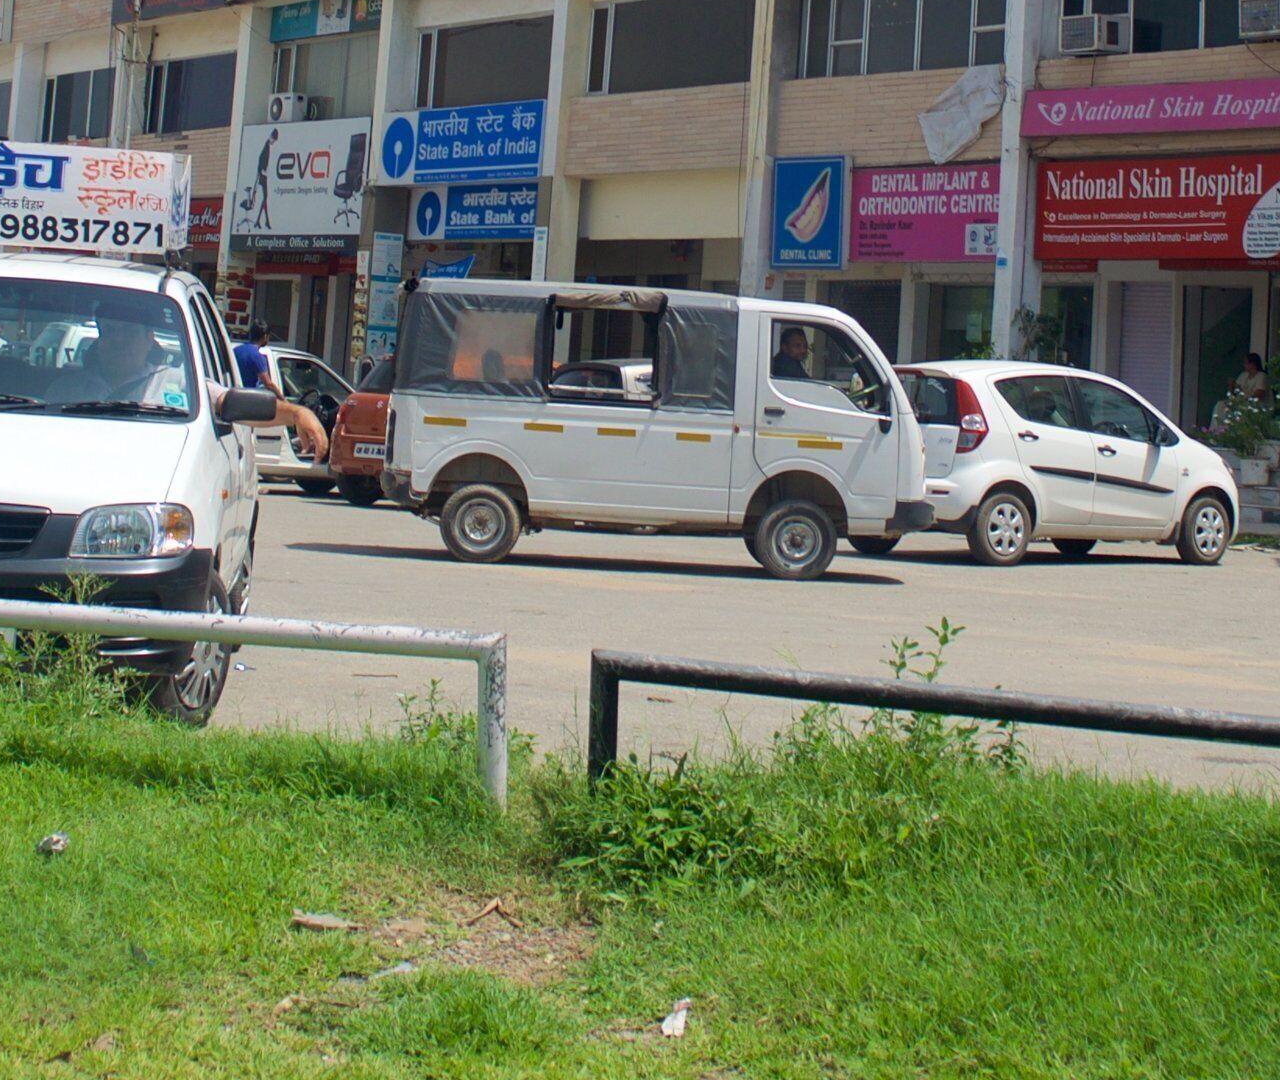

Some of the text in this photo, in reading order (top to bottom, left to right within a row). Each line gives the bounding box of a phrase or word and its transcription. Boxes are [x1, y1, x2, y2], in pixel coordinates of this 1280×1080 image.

[1071, 95, 1155, 121] National
[1160, 94, 1204, 119] Skin
[422, 106, 536, 137] भारतीय स्टेट बैंक
[418, 136, 537, 160] State Bank of India
[872, 171, 989, 193] DENTAL IMPLANT &
[1045, 164, 1263, 205] National Skin Hospital
[463, 186, 536, 207] भारतीय स्टेट
[859, 194, 1000, 216] ORTHODONTIC CENTRE
[450, 210, 535, 225] State Bank of
[1057, 212, 1092, 221] Excellence
[1100, 211, 1141, 222] Dermatology
[1199, 210, 1227, 220] Surgery
[246, 235, 344, 249] A Complete Office Solutions
[1123, 231, 1151, 244] Specialist
[1186, 231, 1202, 242] Laser
[1203, 231, 1228, 244] Surgeon
[780, 248, 832, 260] DENTAL CLINIC
